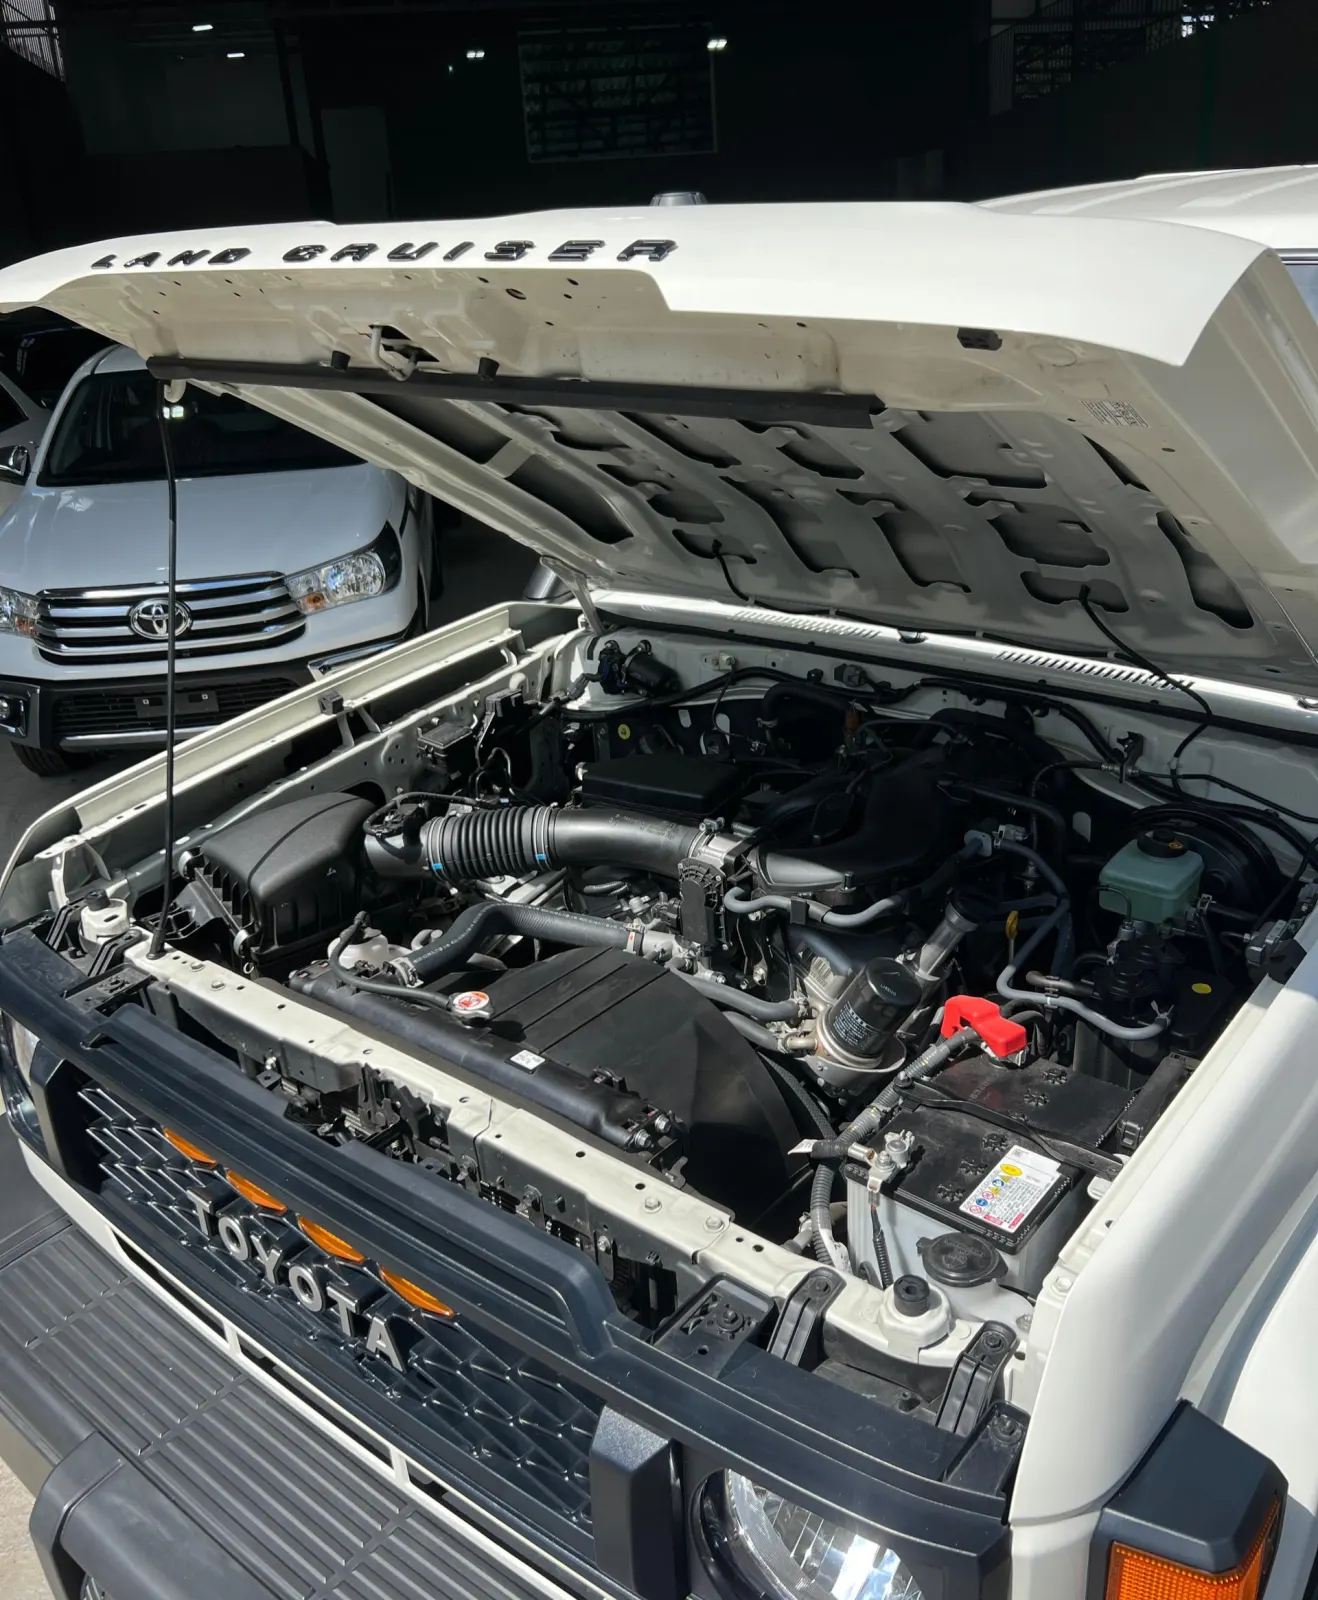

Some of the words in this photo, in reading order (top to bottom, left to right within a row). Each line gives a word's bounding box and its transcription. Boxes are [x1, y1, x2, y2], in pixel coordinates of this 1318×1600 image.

[91, 248, 251, 269] LAND
[282, 239, 678, 263] CRUISER
[186, 1188, 406, 1373] TOYOTA
